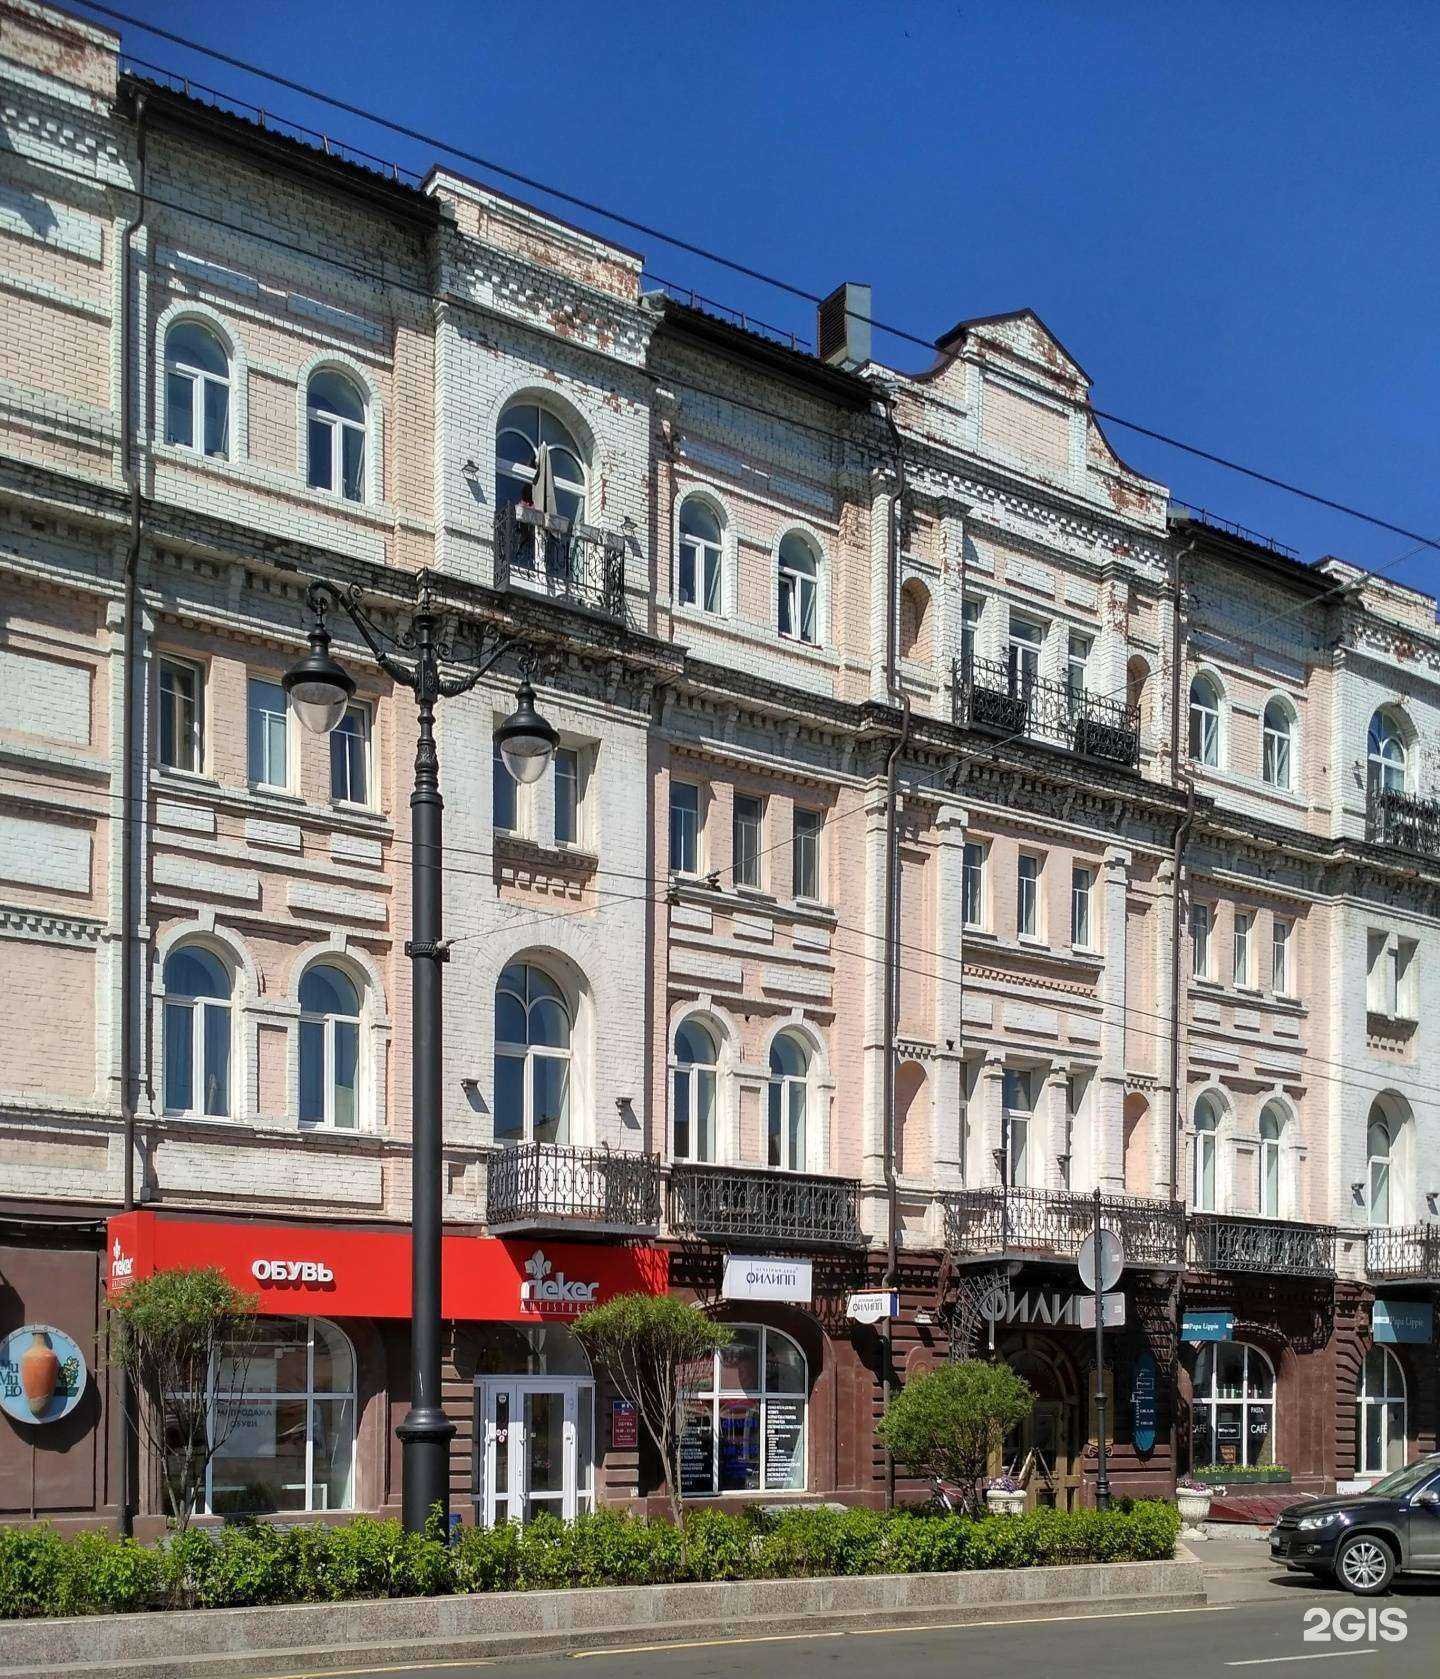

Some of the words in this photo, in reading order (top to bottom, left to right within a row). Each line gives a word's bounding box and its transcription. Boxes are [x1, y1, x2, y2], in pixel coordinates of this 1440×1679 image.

[251, 1259, 334, 1282] ОБУВЬ
[746, 1267, 796, 1286] ФИЛИПП
[520, 1271, 600, 1301] rieker
[979, 1290, 1081, 1327] ФИЛИ
